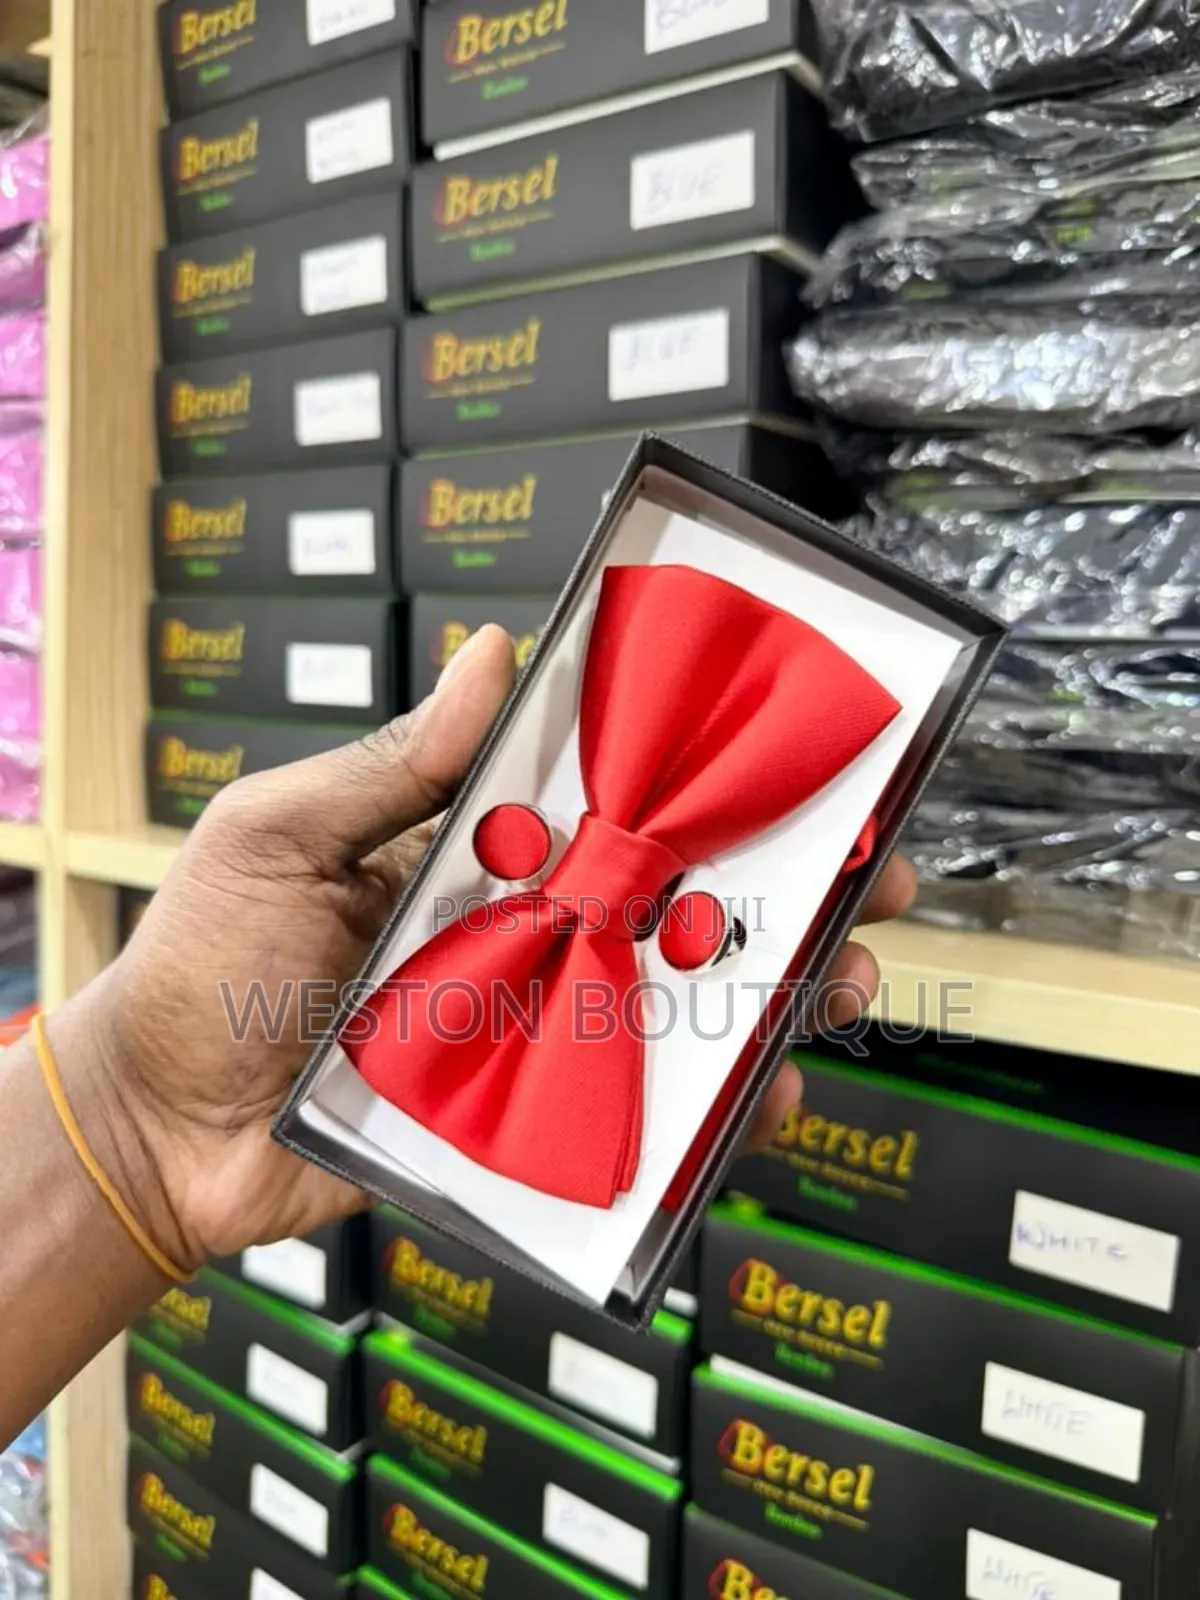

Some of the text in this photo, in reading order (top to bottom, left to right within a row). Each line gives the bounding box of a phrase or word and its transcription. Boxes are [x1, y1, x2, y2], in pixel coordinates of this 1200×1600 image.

[454, 0, 568, 64] Bersel
[178, 116, 260, 181] Bersel
[440, 153, 559, 226] Bersel
[176, 247, 256, 303] Bersel
[430, 315, 542, 382] Bersel
[427, 474, 537, 527] Bersel
[739, 1259, 892, 1350] Bersel
[729, 1419, 876, 1512] Bersel
